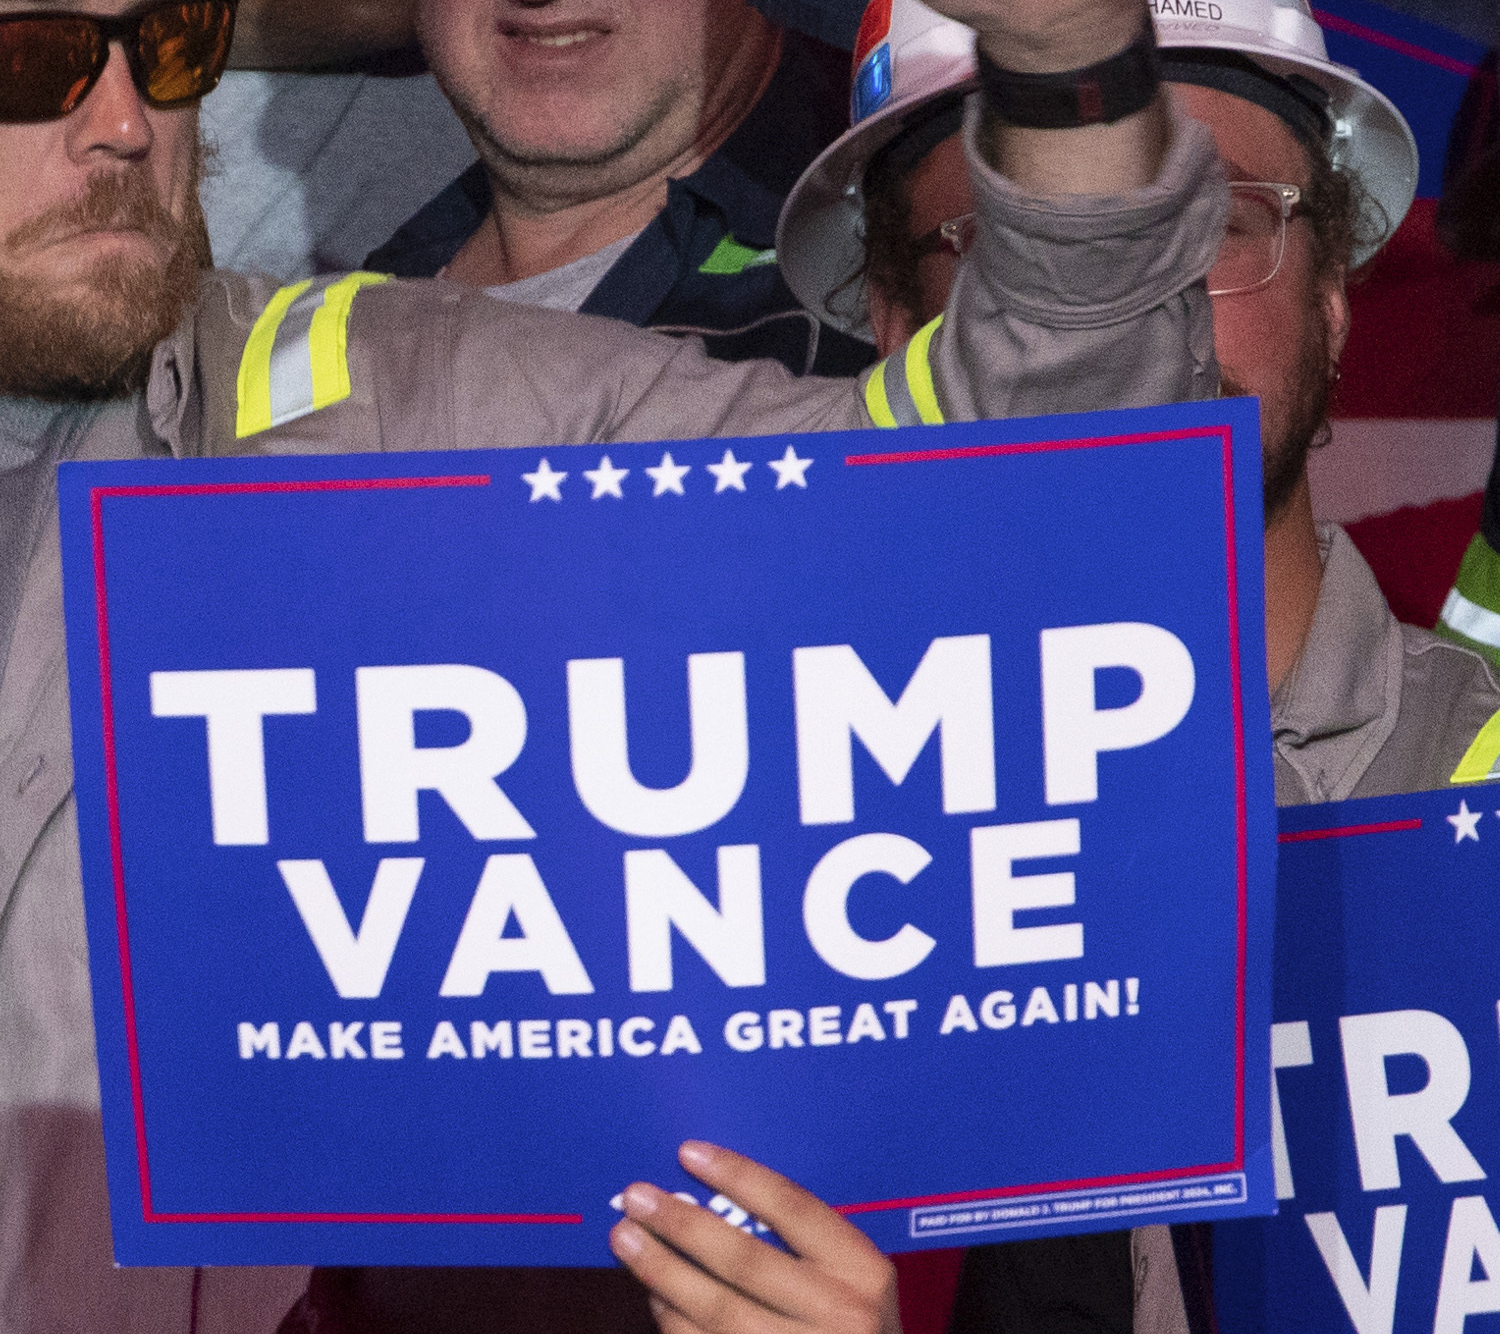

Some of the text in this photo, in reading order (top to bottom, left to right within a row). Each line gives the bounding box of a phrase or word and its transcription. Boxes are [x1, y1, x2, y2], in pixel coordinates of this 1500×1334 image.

[149, 621, 1197, 846] TRUMP
[276, 817, 1086, 999] VANCE
[238, 978, 1142, 1062] MAKE AMERICA GREAT AGAIN!
